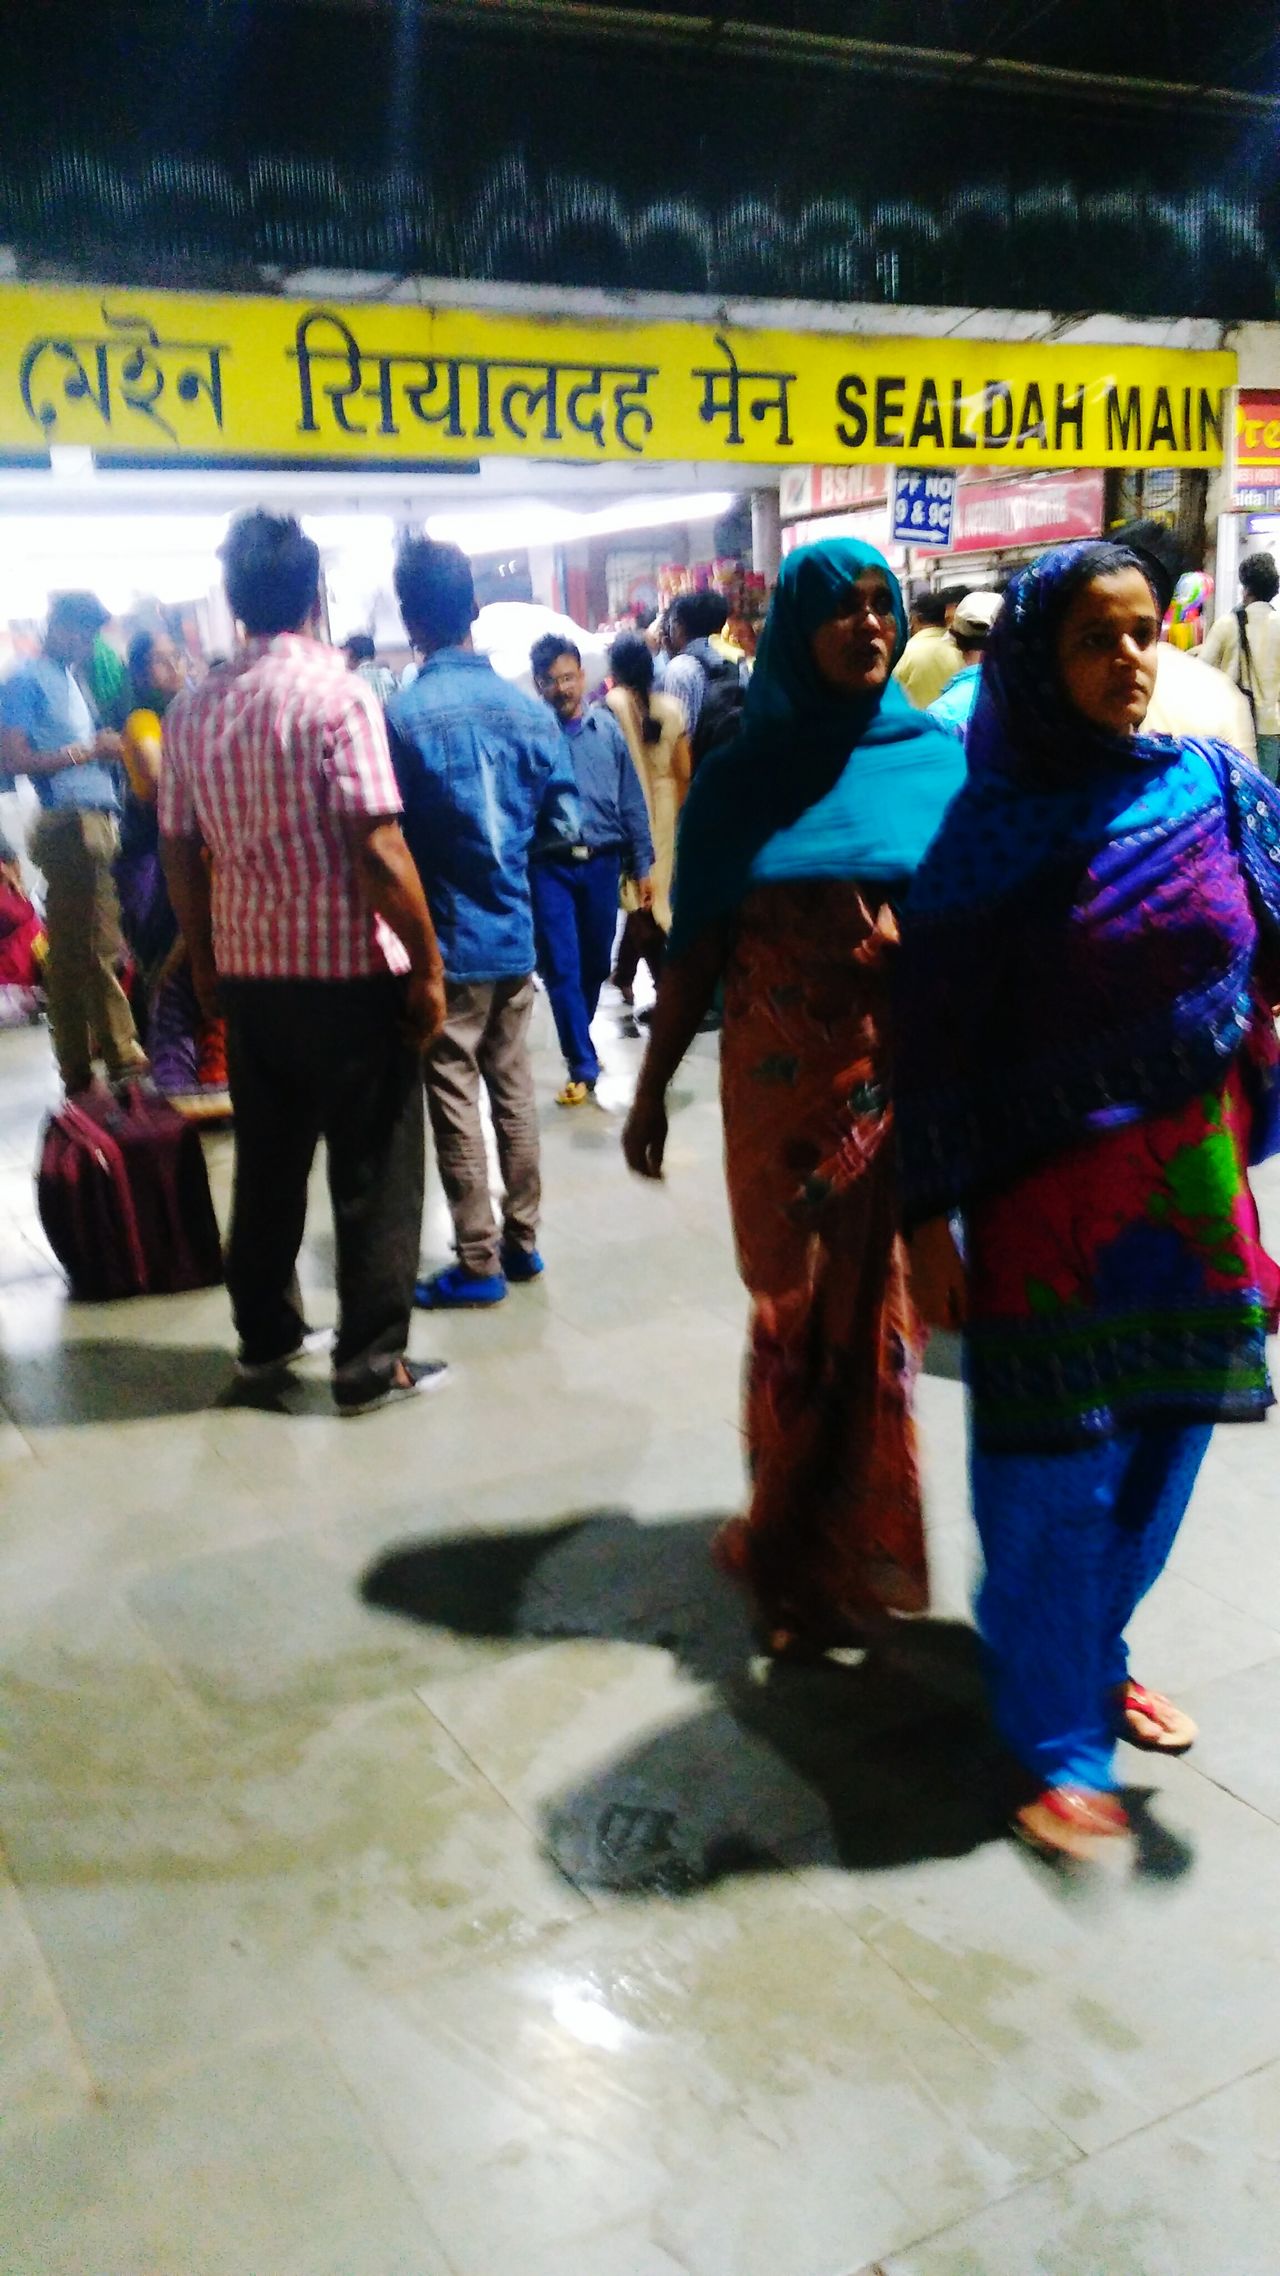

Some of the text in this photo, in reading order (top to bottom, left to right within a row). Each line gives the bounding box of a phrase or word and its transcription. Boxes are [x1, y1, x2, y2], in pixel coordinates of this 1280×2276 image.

[285, 308, 797, 452] सियालदह मेन
[835, 374, 1223, 452] SEALDAH MAIN
[821, 466, 875, 504] BSNL
[925, 473, 953, 500] NO
[895, 498, 909, 523] 9
[910, 500, 926, 526] &
